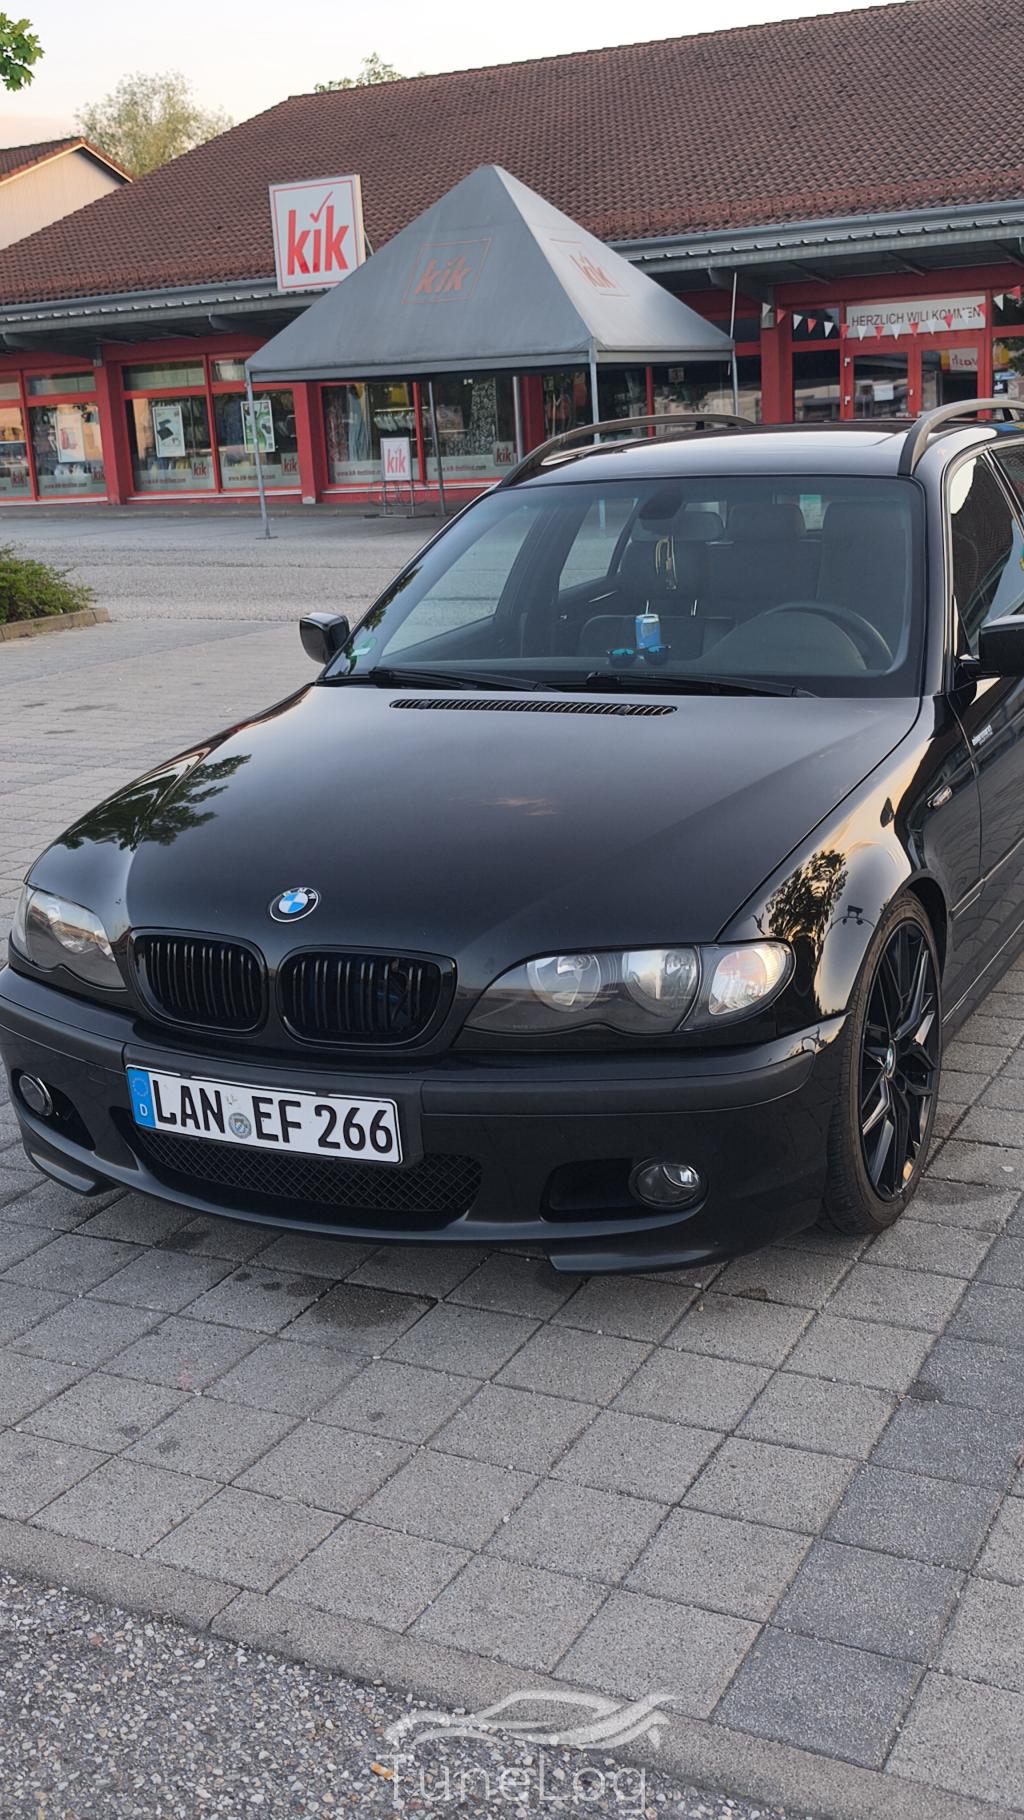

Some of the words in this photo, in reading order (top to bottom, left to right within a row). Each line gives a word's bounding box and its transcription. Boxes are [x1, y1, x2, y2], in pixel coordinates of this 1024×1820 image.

[287, 191, 349, 276] kik
[852, 312, 904, 327] HERZLICH
[139, 1103, 148, 1117] D
[152, 1079, 226, 1134] LAN
[251, 1095, 302, 1144] EF
[314, 1103, 394, 1154] 266
